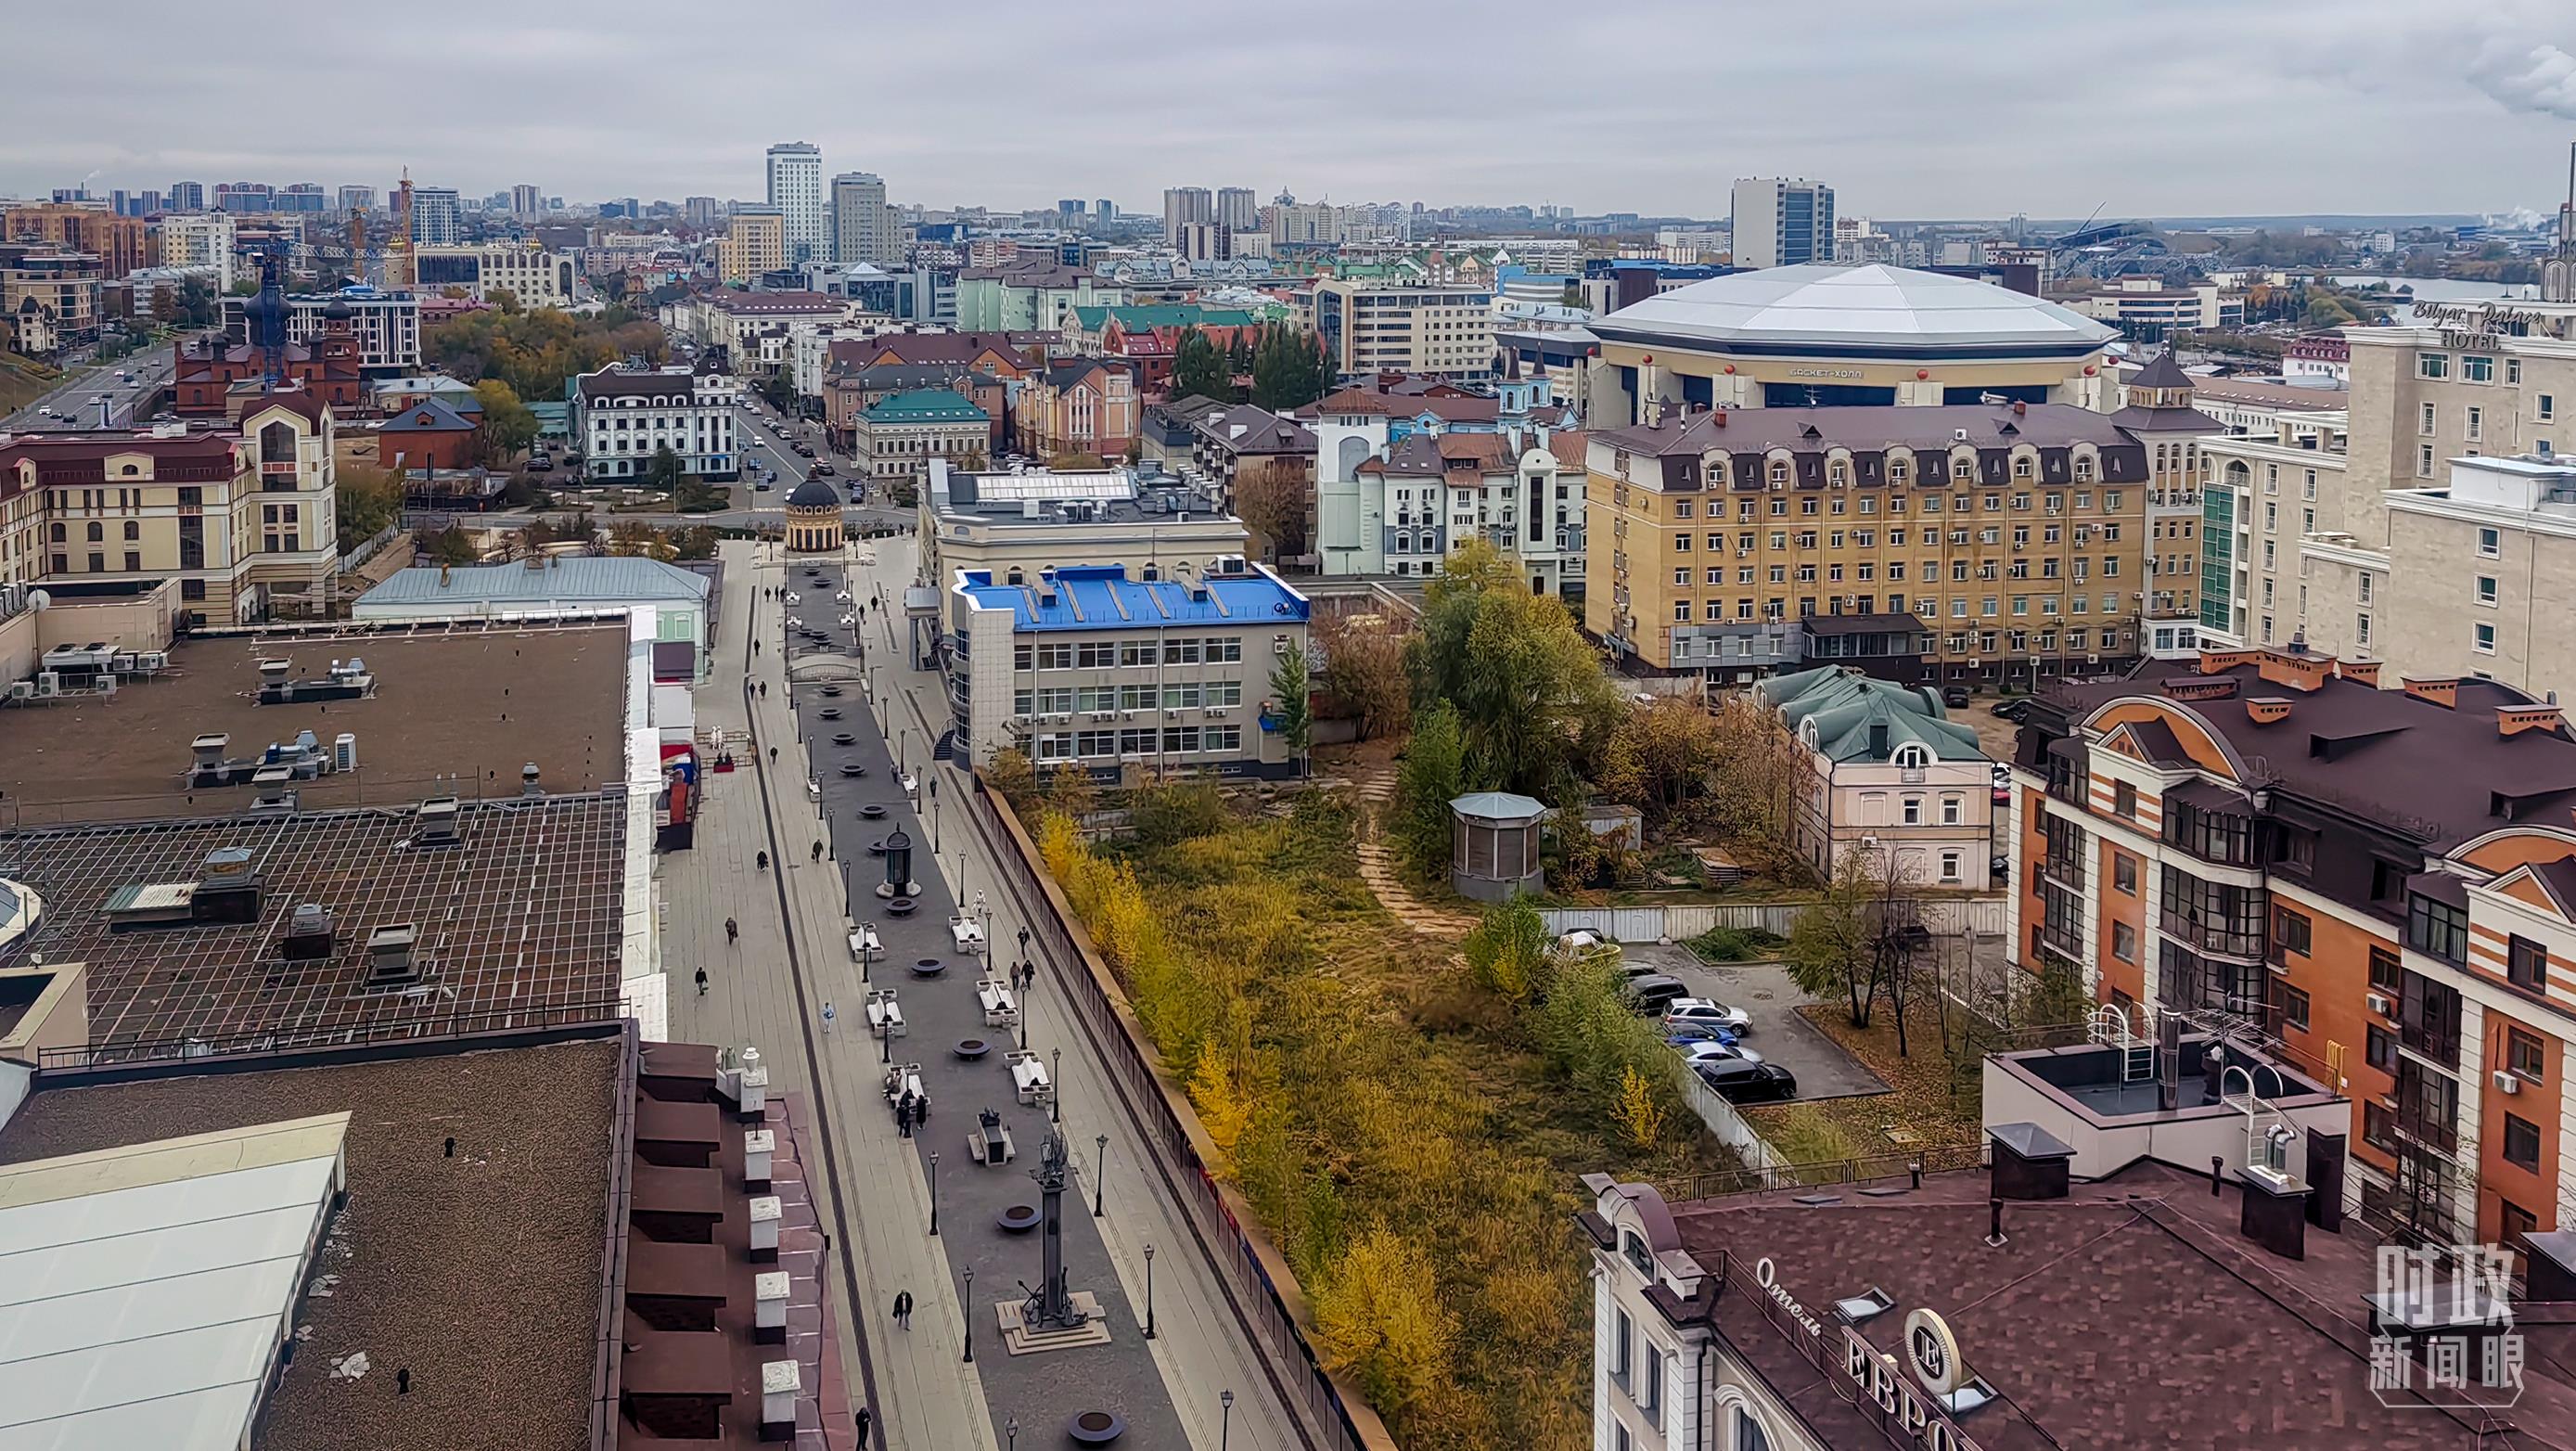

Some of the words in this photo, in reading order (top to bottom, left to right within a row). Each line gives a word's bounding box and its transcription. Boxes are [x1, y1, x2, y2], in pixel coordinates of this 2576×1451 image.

[2410, 300, 2467, 327] Bilyar
[2479, 302, 2542, 327] Palace
[2441, 331, 2502, 350] HOTEL
[1756, 1256, 1822, 1338] Отель
[1840, 1327, 1970, 1451] ЕВРО
